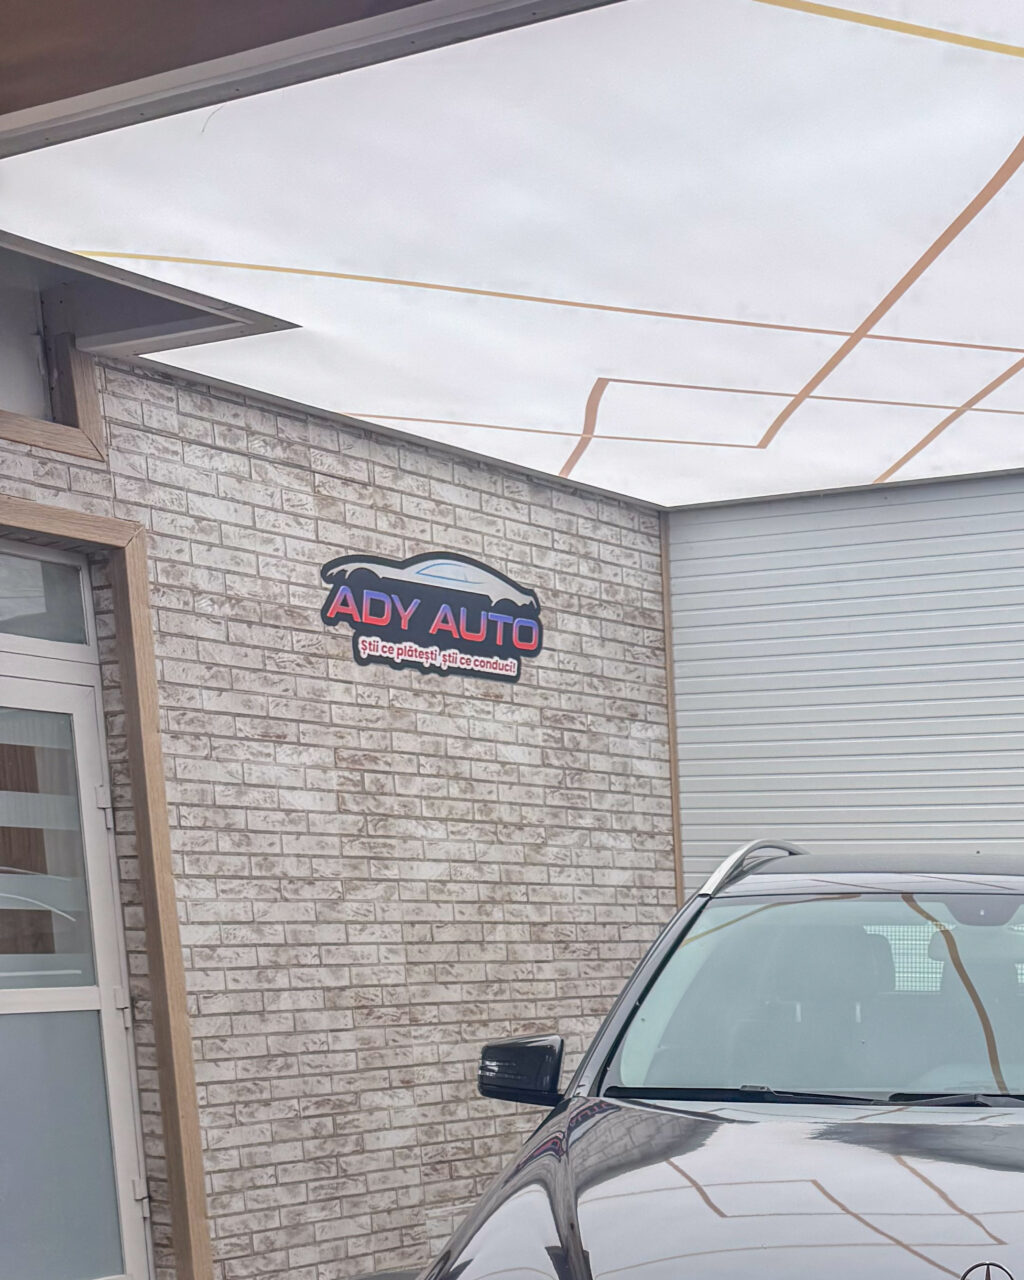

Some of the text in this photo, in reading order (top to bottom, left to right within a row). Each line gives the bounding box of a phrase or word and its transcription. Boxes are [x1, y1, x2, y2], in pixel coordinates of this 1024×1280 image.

[326, 585, 539, 651] ADY AUTO
[360, 639, 379, 656] Știi
[381, 643, 394, 655] ce
[442, 652, 458, 667] știi
[459, 654, 472, 666] ce
[473, 655, 516, 673] conduci!
